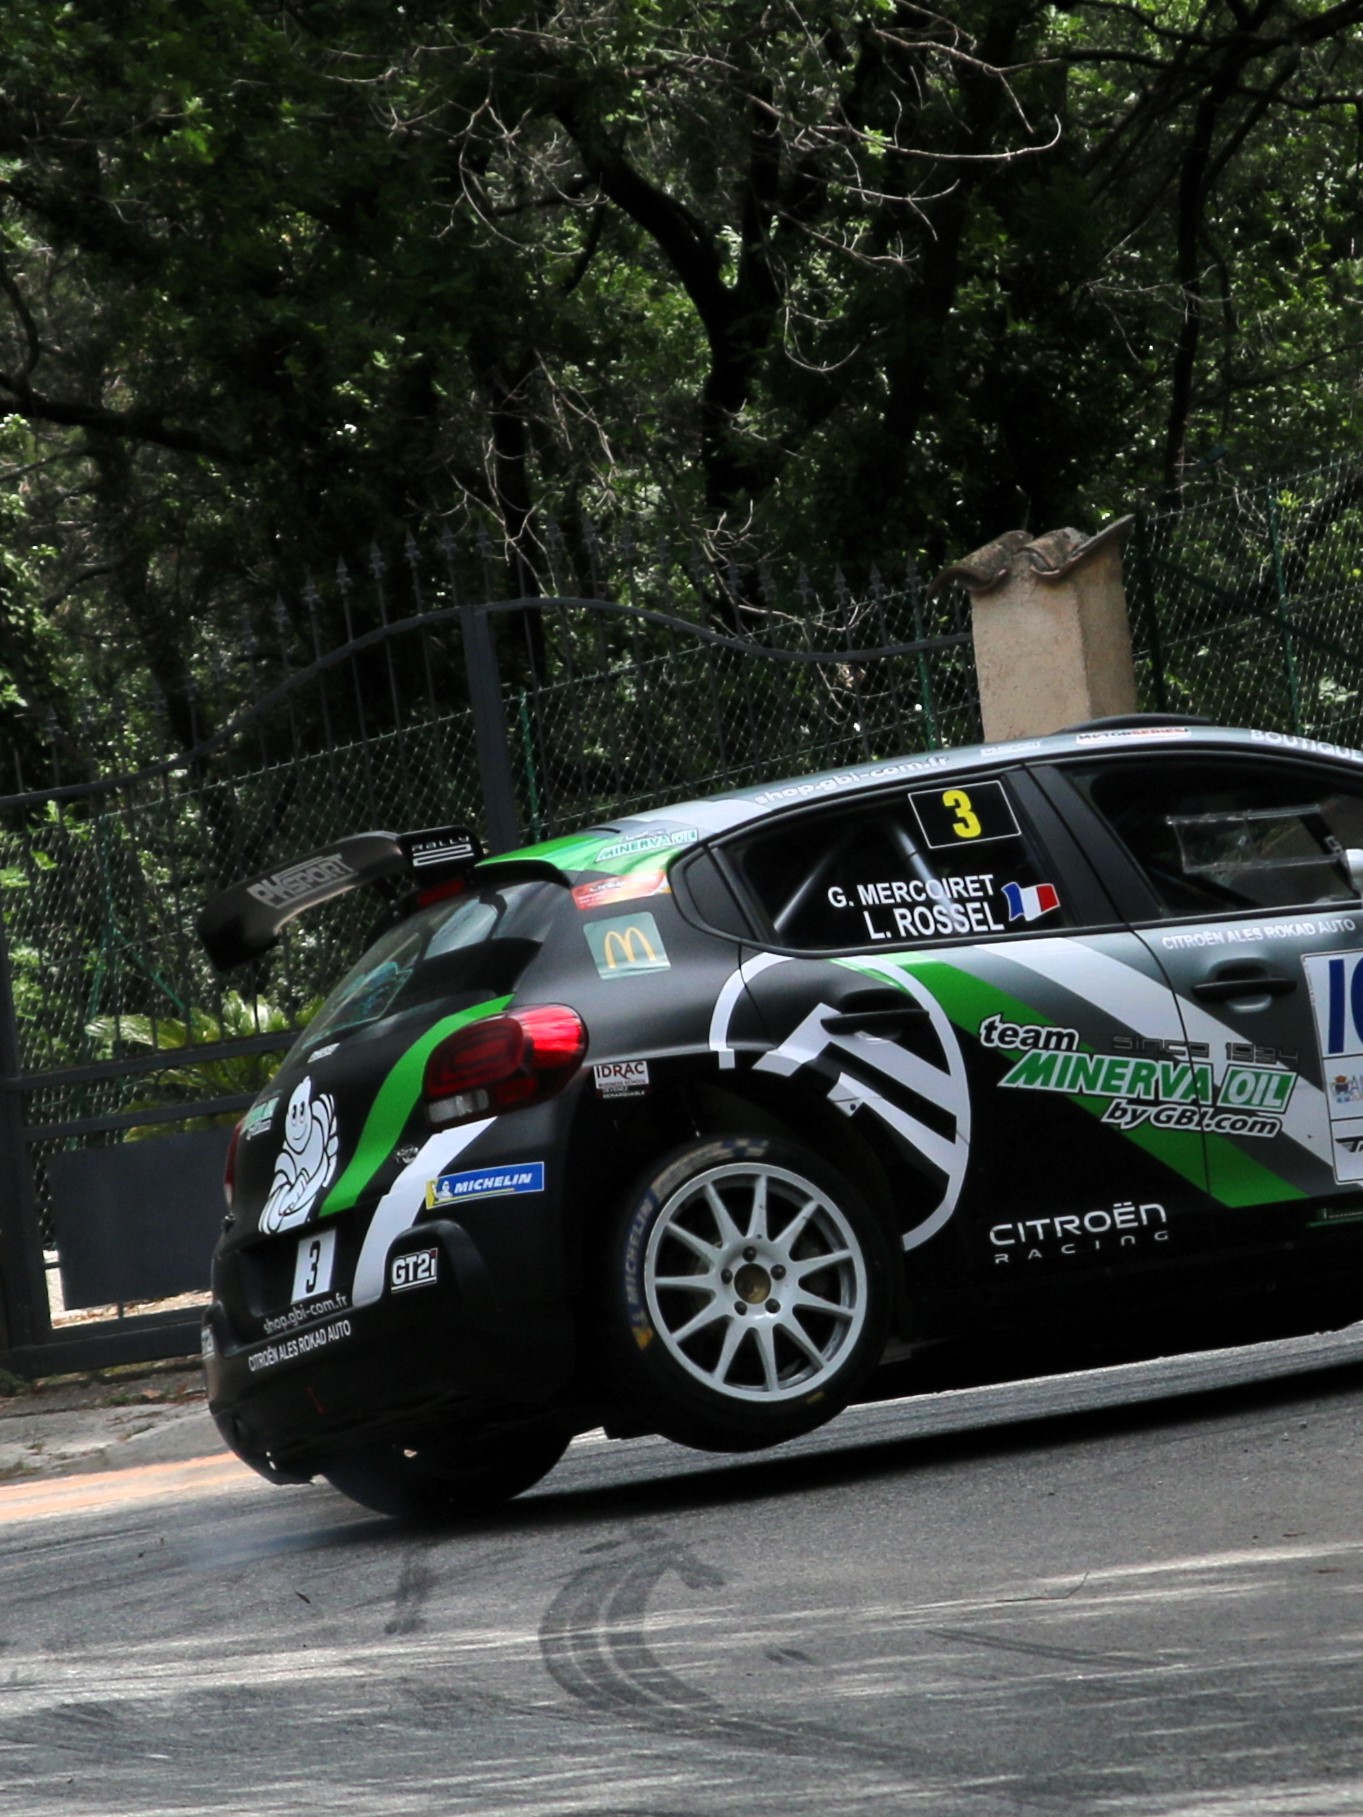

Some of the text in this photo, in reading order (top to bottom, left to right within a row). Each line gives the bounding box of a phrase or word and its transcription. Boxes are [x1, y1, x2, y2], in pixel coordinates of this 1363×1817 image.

[754, 755, 949, 804] shop.gbi-com.fr
[942, 789, 981, 838] 3
[600, 834, 671, 859] MINERVA
[828, 874, 994, 907] G. MERCOIRET
[863, 901, 1005, 939] L. ROSSEL
[1228, 927, 1264, 943] ALES
[1267, 923, 1317, 939] ROKAD
[1318, 919, 1356, 933] AUTO
[981, 1014, 1078, 1051] team
[596, 1062, 645, 1079] IDRAC
[999, 1049, 1285, 1107] MINERVA OIL
[454, 1172, 532, 1194] MICHELIN
[990, 1201, 1167, 1246] CITROËN
[995, 1231, 1168, 1264] RACING
[305, 1240, 321, 1294] 3
[392, 1253, 436, 1285] GT2i
[264, 1293, 347, 1334] shop.gbi-com.fr
[279, 1340, 298, 1360] ALES
[298, 1328, 327, 1353] ROKAD
[328, 1320, 351, 1342] AUTO
